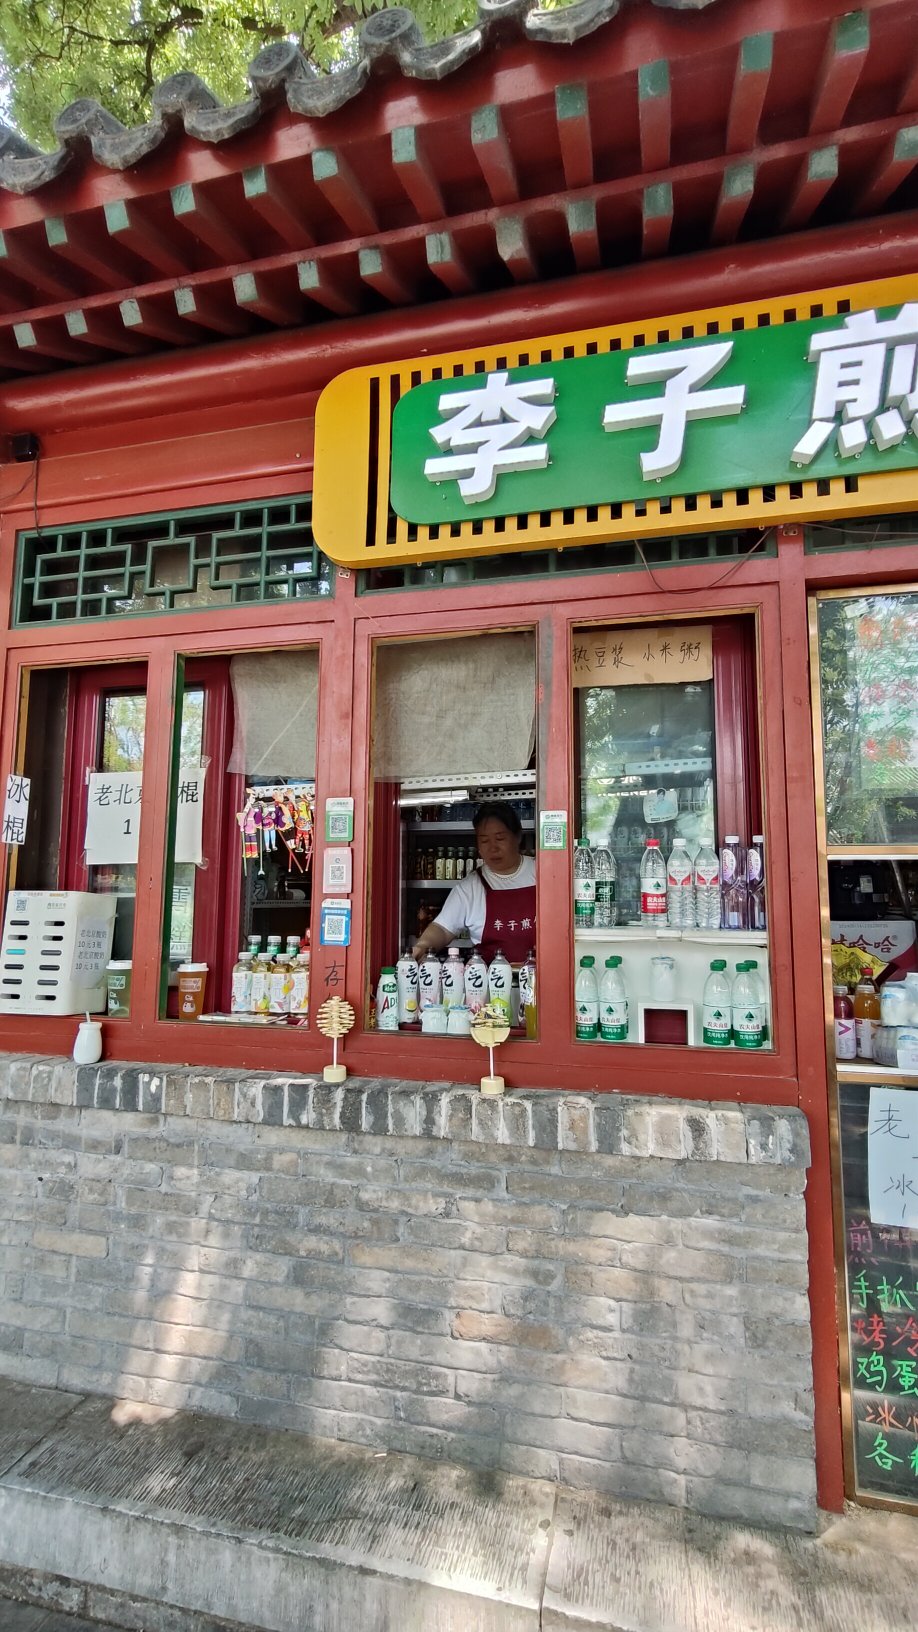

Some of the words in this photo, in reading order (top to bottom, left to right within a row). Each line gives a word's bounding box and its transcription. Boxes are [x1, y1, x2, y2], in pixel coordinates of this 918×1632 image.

[424, 301, 918, 505] 李子煎
[572, 641, 634, 672] 热豆浆
[642, 641, 701, 664] 小米粥
[3, 775, 30, 844] 冰棍
[123, 818, 132, 835] 1
[493, 916, 537, 931] 李子煎
[381, 995, 398, 1014] AD
[870, 1103, 910, 1139] 老
[851, 1269, 918, 1313] 手抓
[856, 1351, 918, 1396] 鸡蛋
